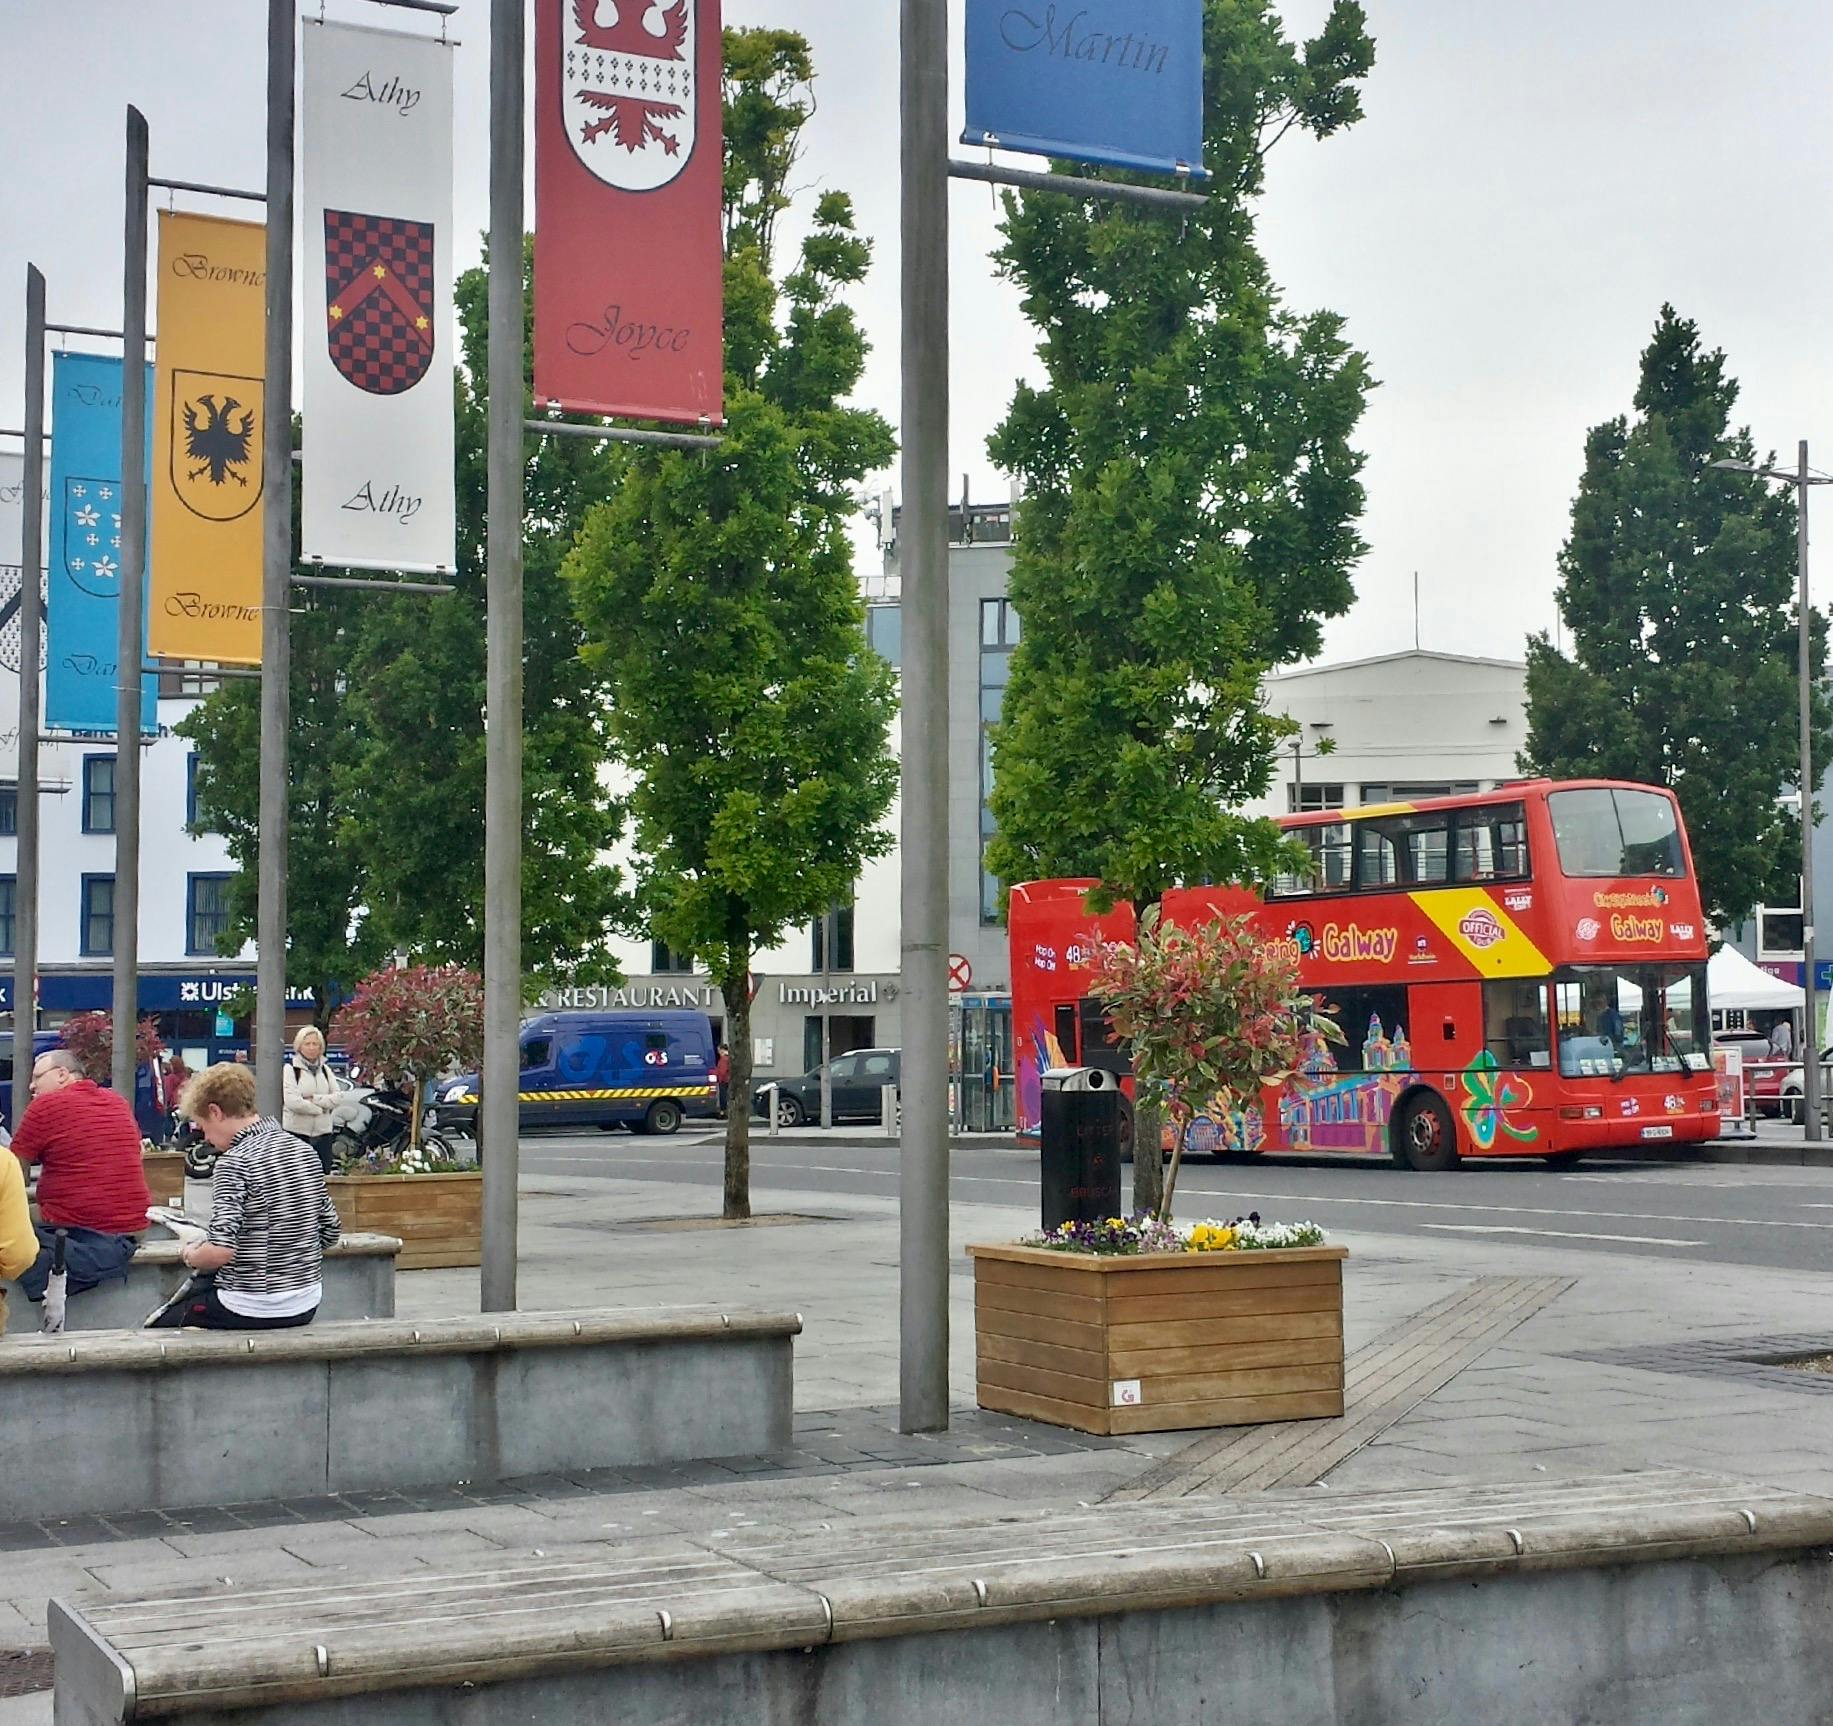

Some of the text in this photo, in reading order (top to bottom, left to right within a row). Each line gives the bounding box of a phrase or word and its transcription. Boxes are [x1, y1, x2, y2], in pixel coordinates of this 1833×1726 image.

[1000, 3, 1169, 74] Martin
[340, 70, 422, 117] Athy
[172, 252, 267, 287] Browne
[566, 304, 691, 361] Joyce
[340, 480, 423, 526] Athy
[164, 591, 261, 622] Browne
[62, 653, 118, 676] Dar
[1323, 922, 1398, 963] Galway
[1462, 921, 1504, 938] OFFICIAL
[1610, 913, 1664, 943] Galway
[1066, 945, 1080, 963] 48
[202, 982, 258, 1001] Ulst
[558, 986, 714, 1008] RESTAURANT
[779, 980, 877, 1009] Imperial
